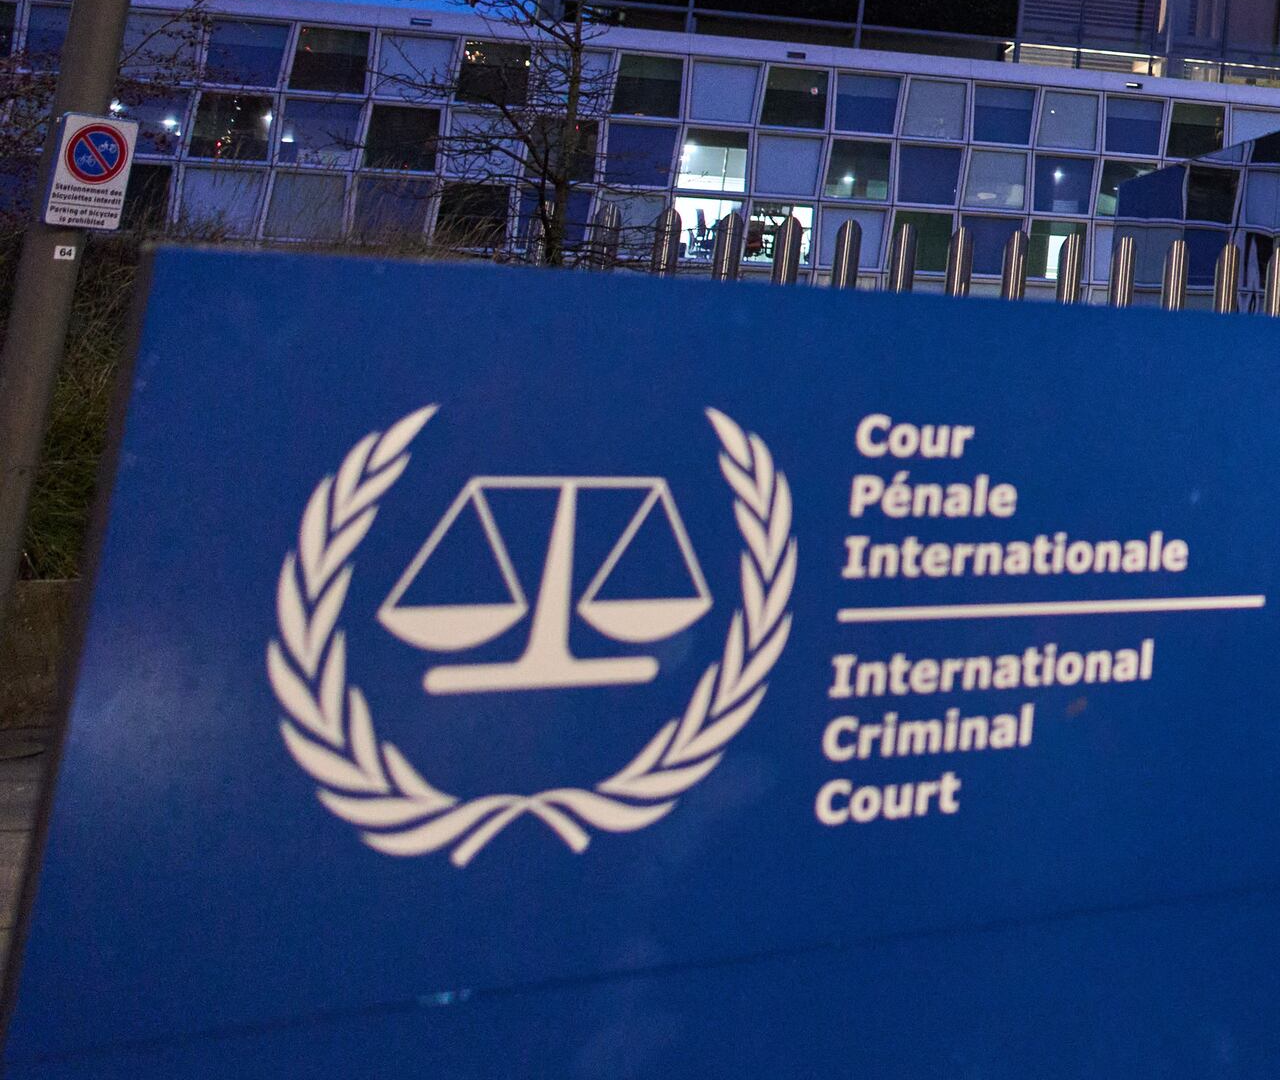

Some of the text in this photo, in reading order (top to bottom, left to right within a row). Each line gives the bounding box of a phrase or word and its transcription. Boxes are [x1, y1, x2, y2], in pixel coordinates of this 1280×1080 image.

[52, 192, 121, 205] bicyclettes interdit
[55, 183, 108, 193] Stationnement
[50, 205, 78, 215] Parking
[89, 209, 118, 218] bicycles
[67, 217, 105, 226] prohibited
[59, 248, 72, 257] 64
[855, 413, 976, 459] Cour
[849, 470, 1018, 519] Pénale
[841, 530, 1189, 580] Internationale
[827, 638, 1155, 700] International
[821, 702, 1035, 763] Criminal
[814, 771, 962, 827] Court
